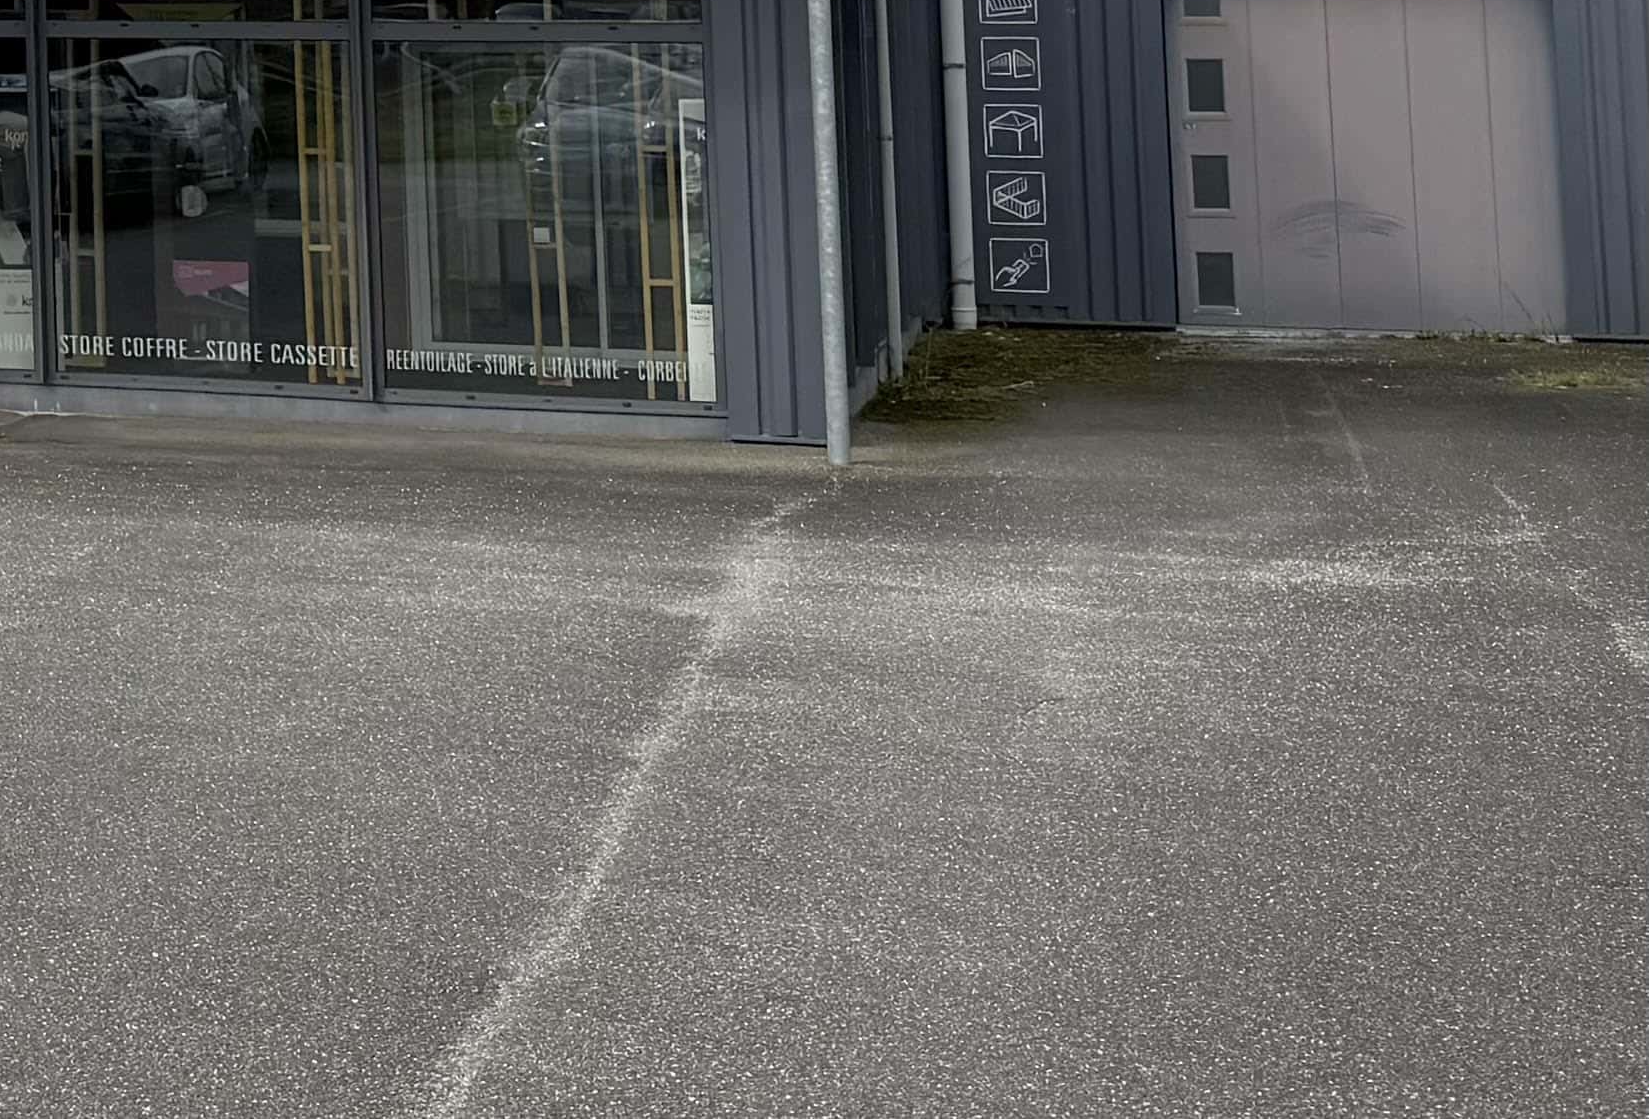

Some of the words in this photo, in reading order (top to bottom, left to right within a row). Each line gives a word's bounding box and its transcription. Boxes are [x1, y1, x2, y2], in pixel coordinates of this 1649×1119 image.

[59, 334, 114, 356] STORE
[122, 337, 188, 358] COFFRE
[206, 340, 263, 363] STORE
[270, 343, 359, 369] CASSETTE
[387, 349, 473, 374] REENTOILAGE
[484, 353, 526, 376] STORE
[637, 360, 708, 382] CORBEI
